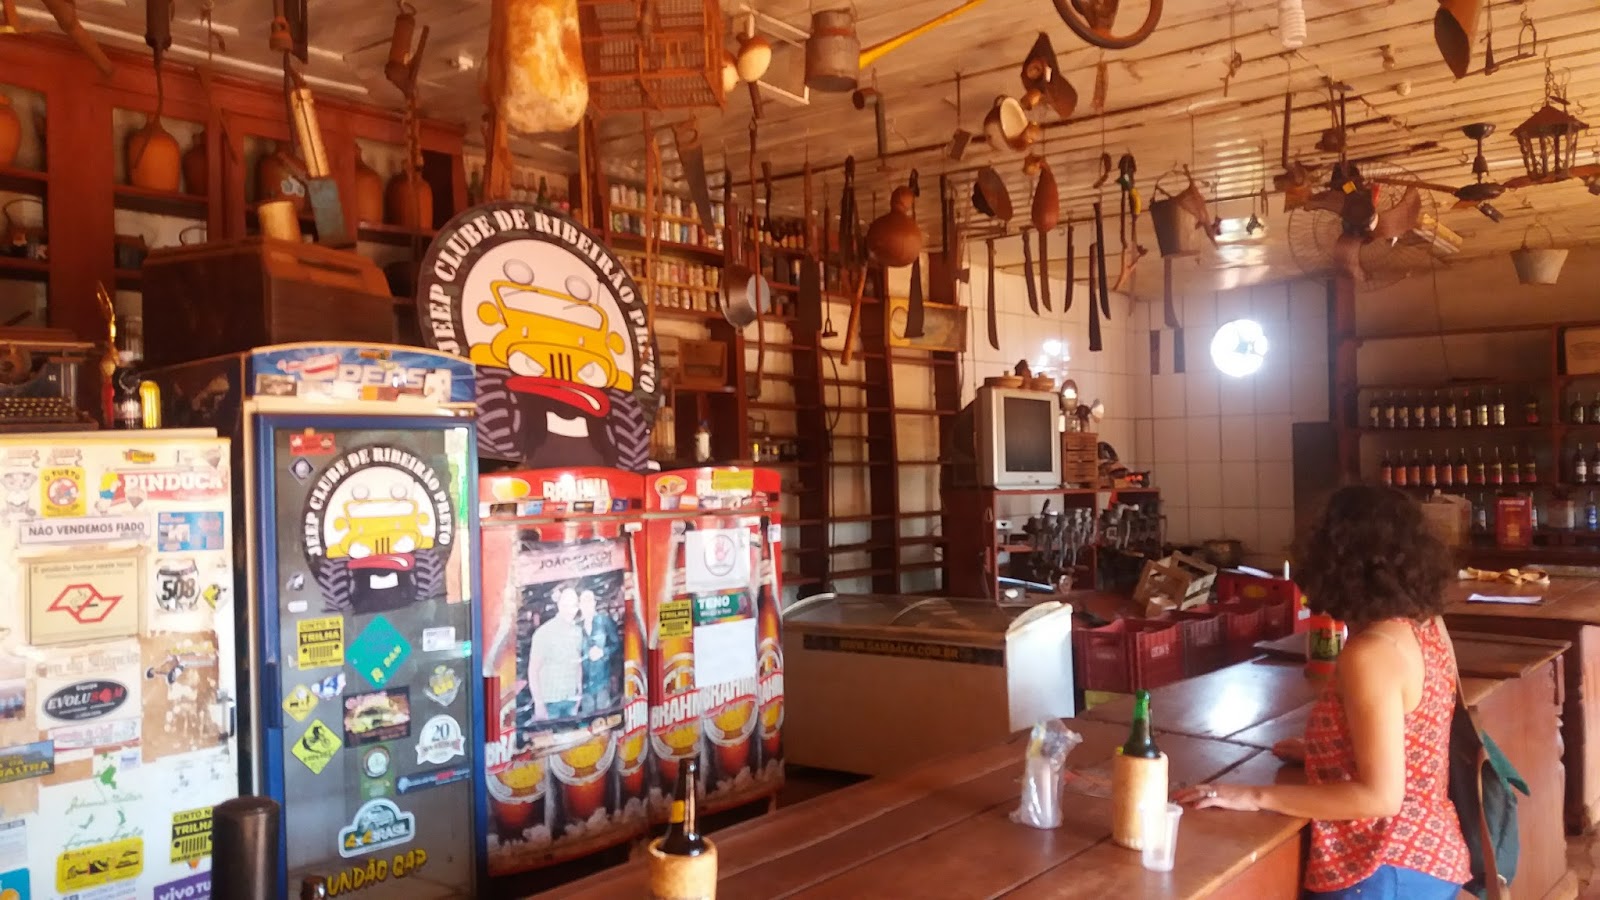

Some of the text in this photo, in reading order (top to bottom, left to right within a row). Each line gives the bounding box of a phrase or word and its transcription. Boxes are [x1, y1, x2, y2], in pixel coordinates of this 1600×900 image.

[492, 207, 530, 231] DE
[434, 215, 496, 282] CLUBE
[534, 211, 636, 304] RIBEIRÃO
[429, 283, 461, 357] JEEP
[338, 365, 426, 388] PEPS
[124, 472, 223, 492] PINDUCA
[305, 447, 452, 556] JEEP CLUBE DE RIBEIRÃO PRETO
[28, 521, 146, 537] NÃO VENDEMOS FIADO
[161, 577, 196, 601] 508
[326, 859, 389, 897] UNDÃO
